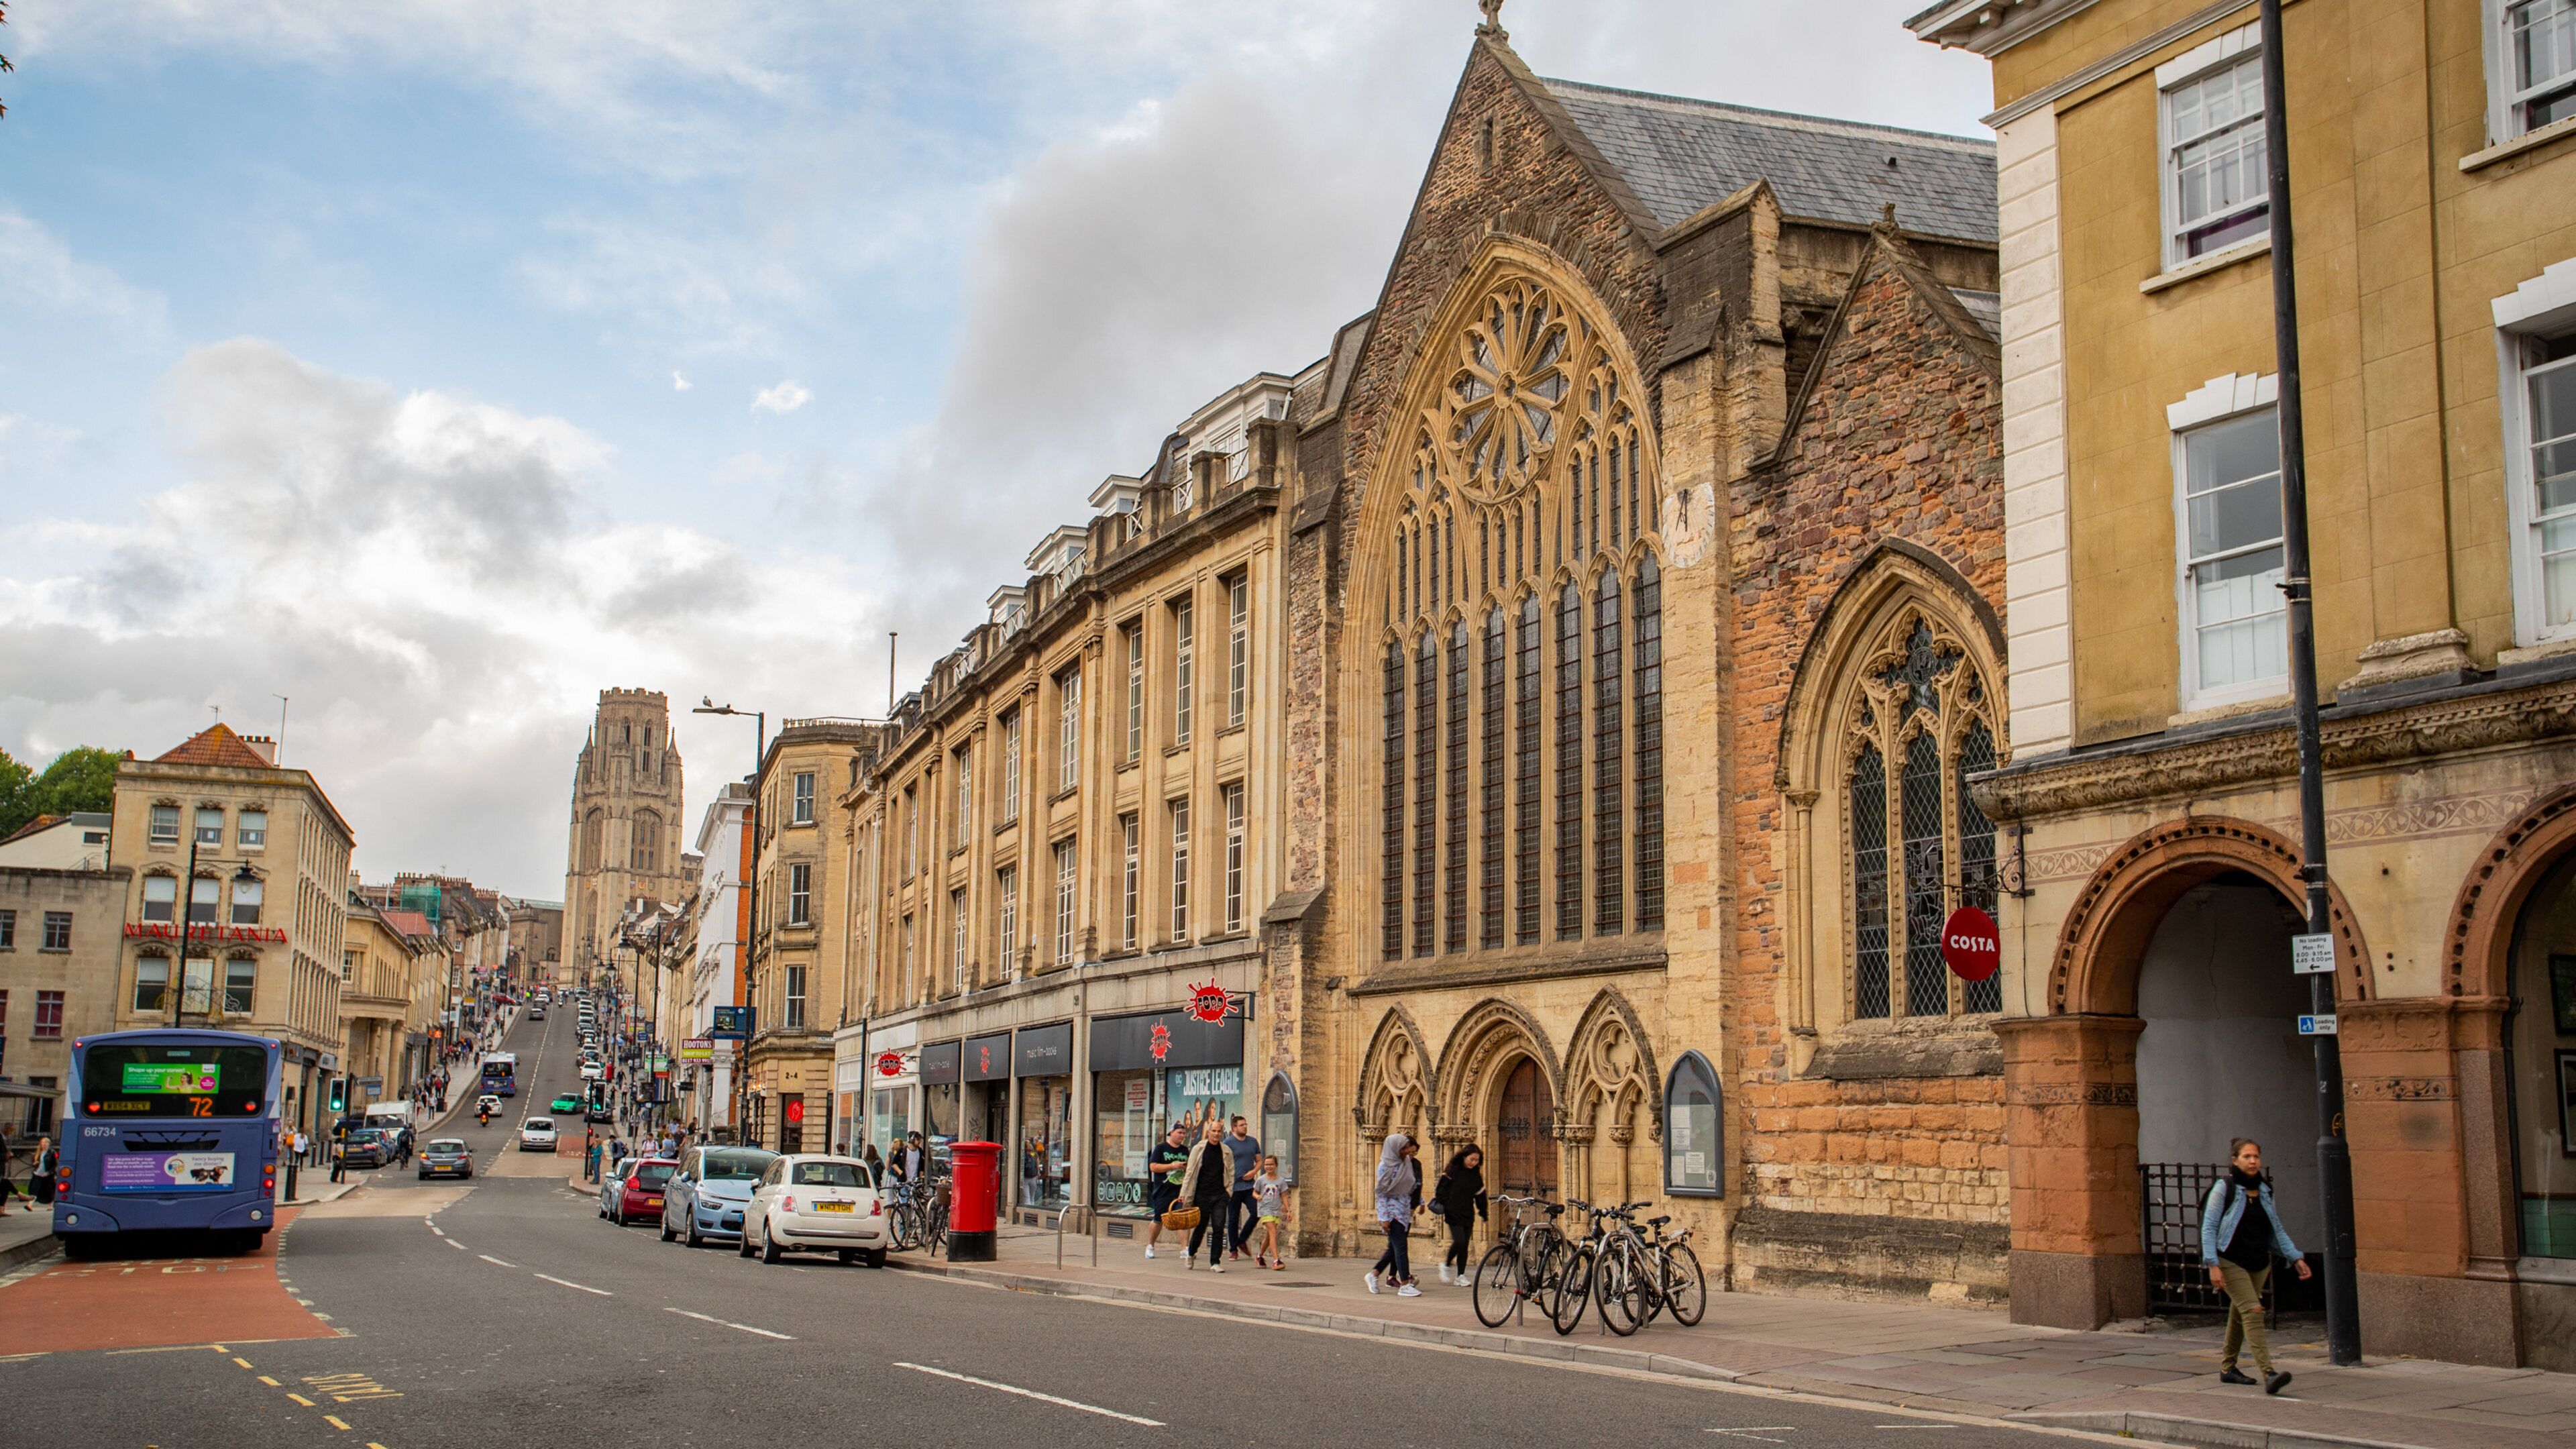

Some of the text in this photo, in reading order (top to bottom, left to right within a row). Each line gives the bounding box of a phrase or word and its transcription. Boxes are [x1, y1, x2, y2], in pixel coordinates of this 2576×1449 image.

[123, 922, 288, 945] MAURETANIA
[1950, 934, 1996, 952] COSTA
[1197, 995, 1223, 1012] FOPP
[684, 1040, 712, 1049] HOOTONS
[879, 1059, 899, 1071] FOPP
[1183, 1067, 1240, 1095] JUSTICE LEAGUE
[190, 1097, 213, 1116] 72
[85, 1127, 116, 1136] 66734
[40, 1263, 265, 1279] STOP
[301, 1373, 405, 1402] TAXIS
